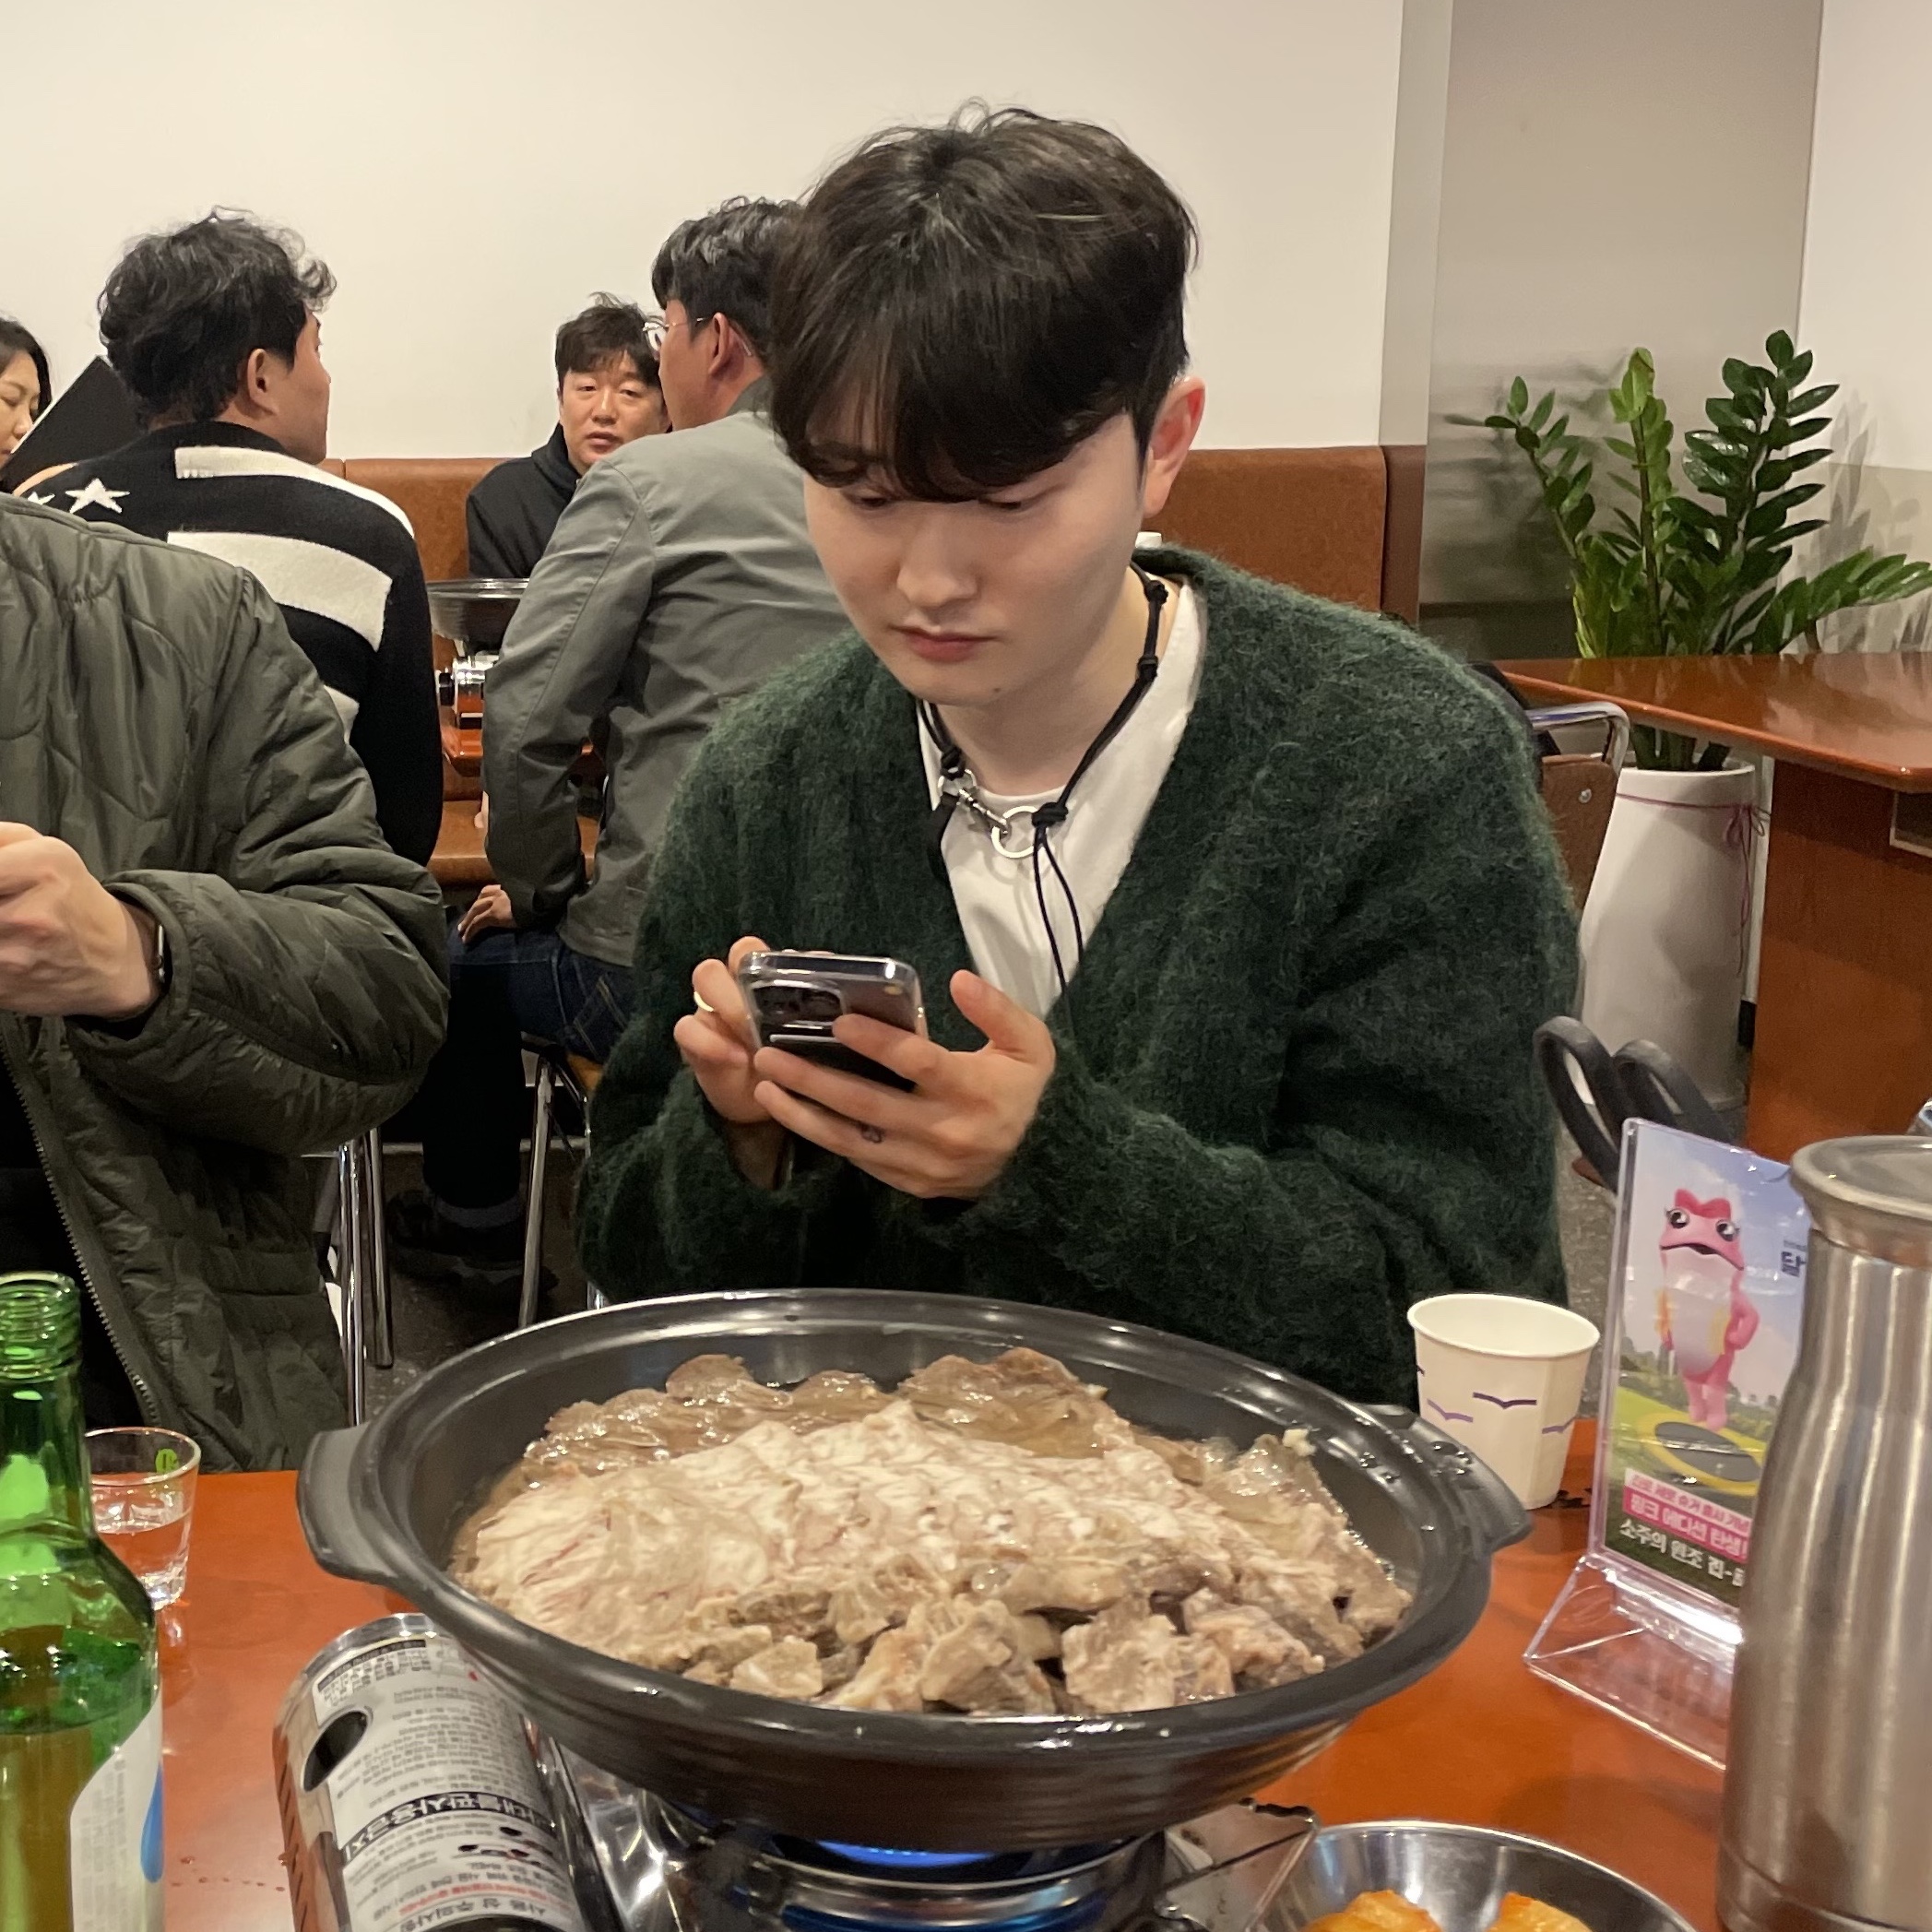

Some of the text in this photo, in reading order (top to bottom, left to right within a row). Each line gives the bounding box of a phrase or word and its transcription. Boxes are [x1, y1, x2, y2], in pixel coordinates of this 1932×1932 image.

[1630, 1493, 1659, 1521] 핑크
[1662, 1507, 1707, 1542] 에디션
[1619, 1519, 1666, 1553] 소주의
[1671, 1540, 1703, 1569] 원조
